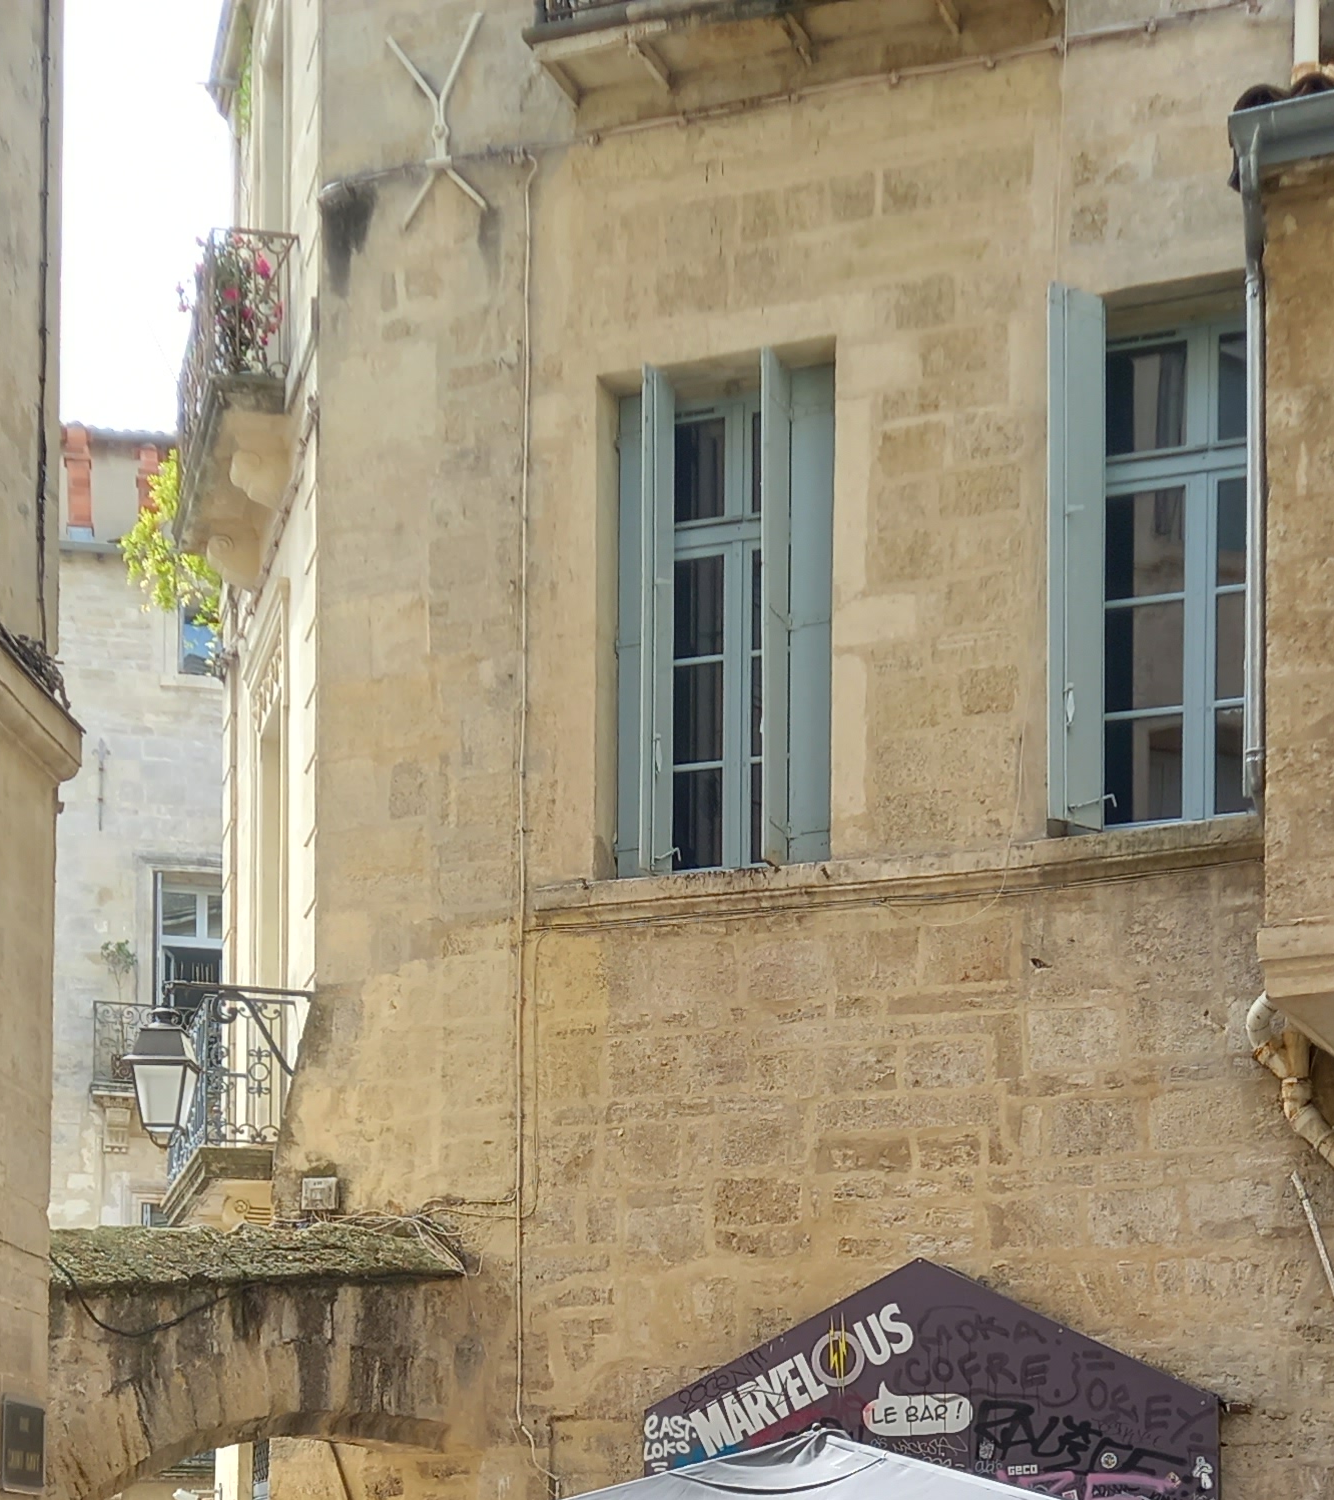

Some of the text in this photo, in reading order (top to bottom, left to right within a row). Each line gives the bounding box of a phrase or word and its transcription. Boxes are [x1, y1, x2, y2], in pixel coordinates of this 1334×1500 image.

[688, 1302, 914, 1458] MARVELOUS
[871, 1406, 898, 1425] LE
[905, 1402, 947, 1424] BAR
